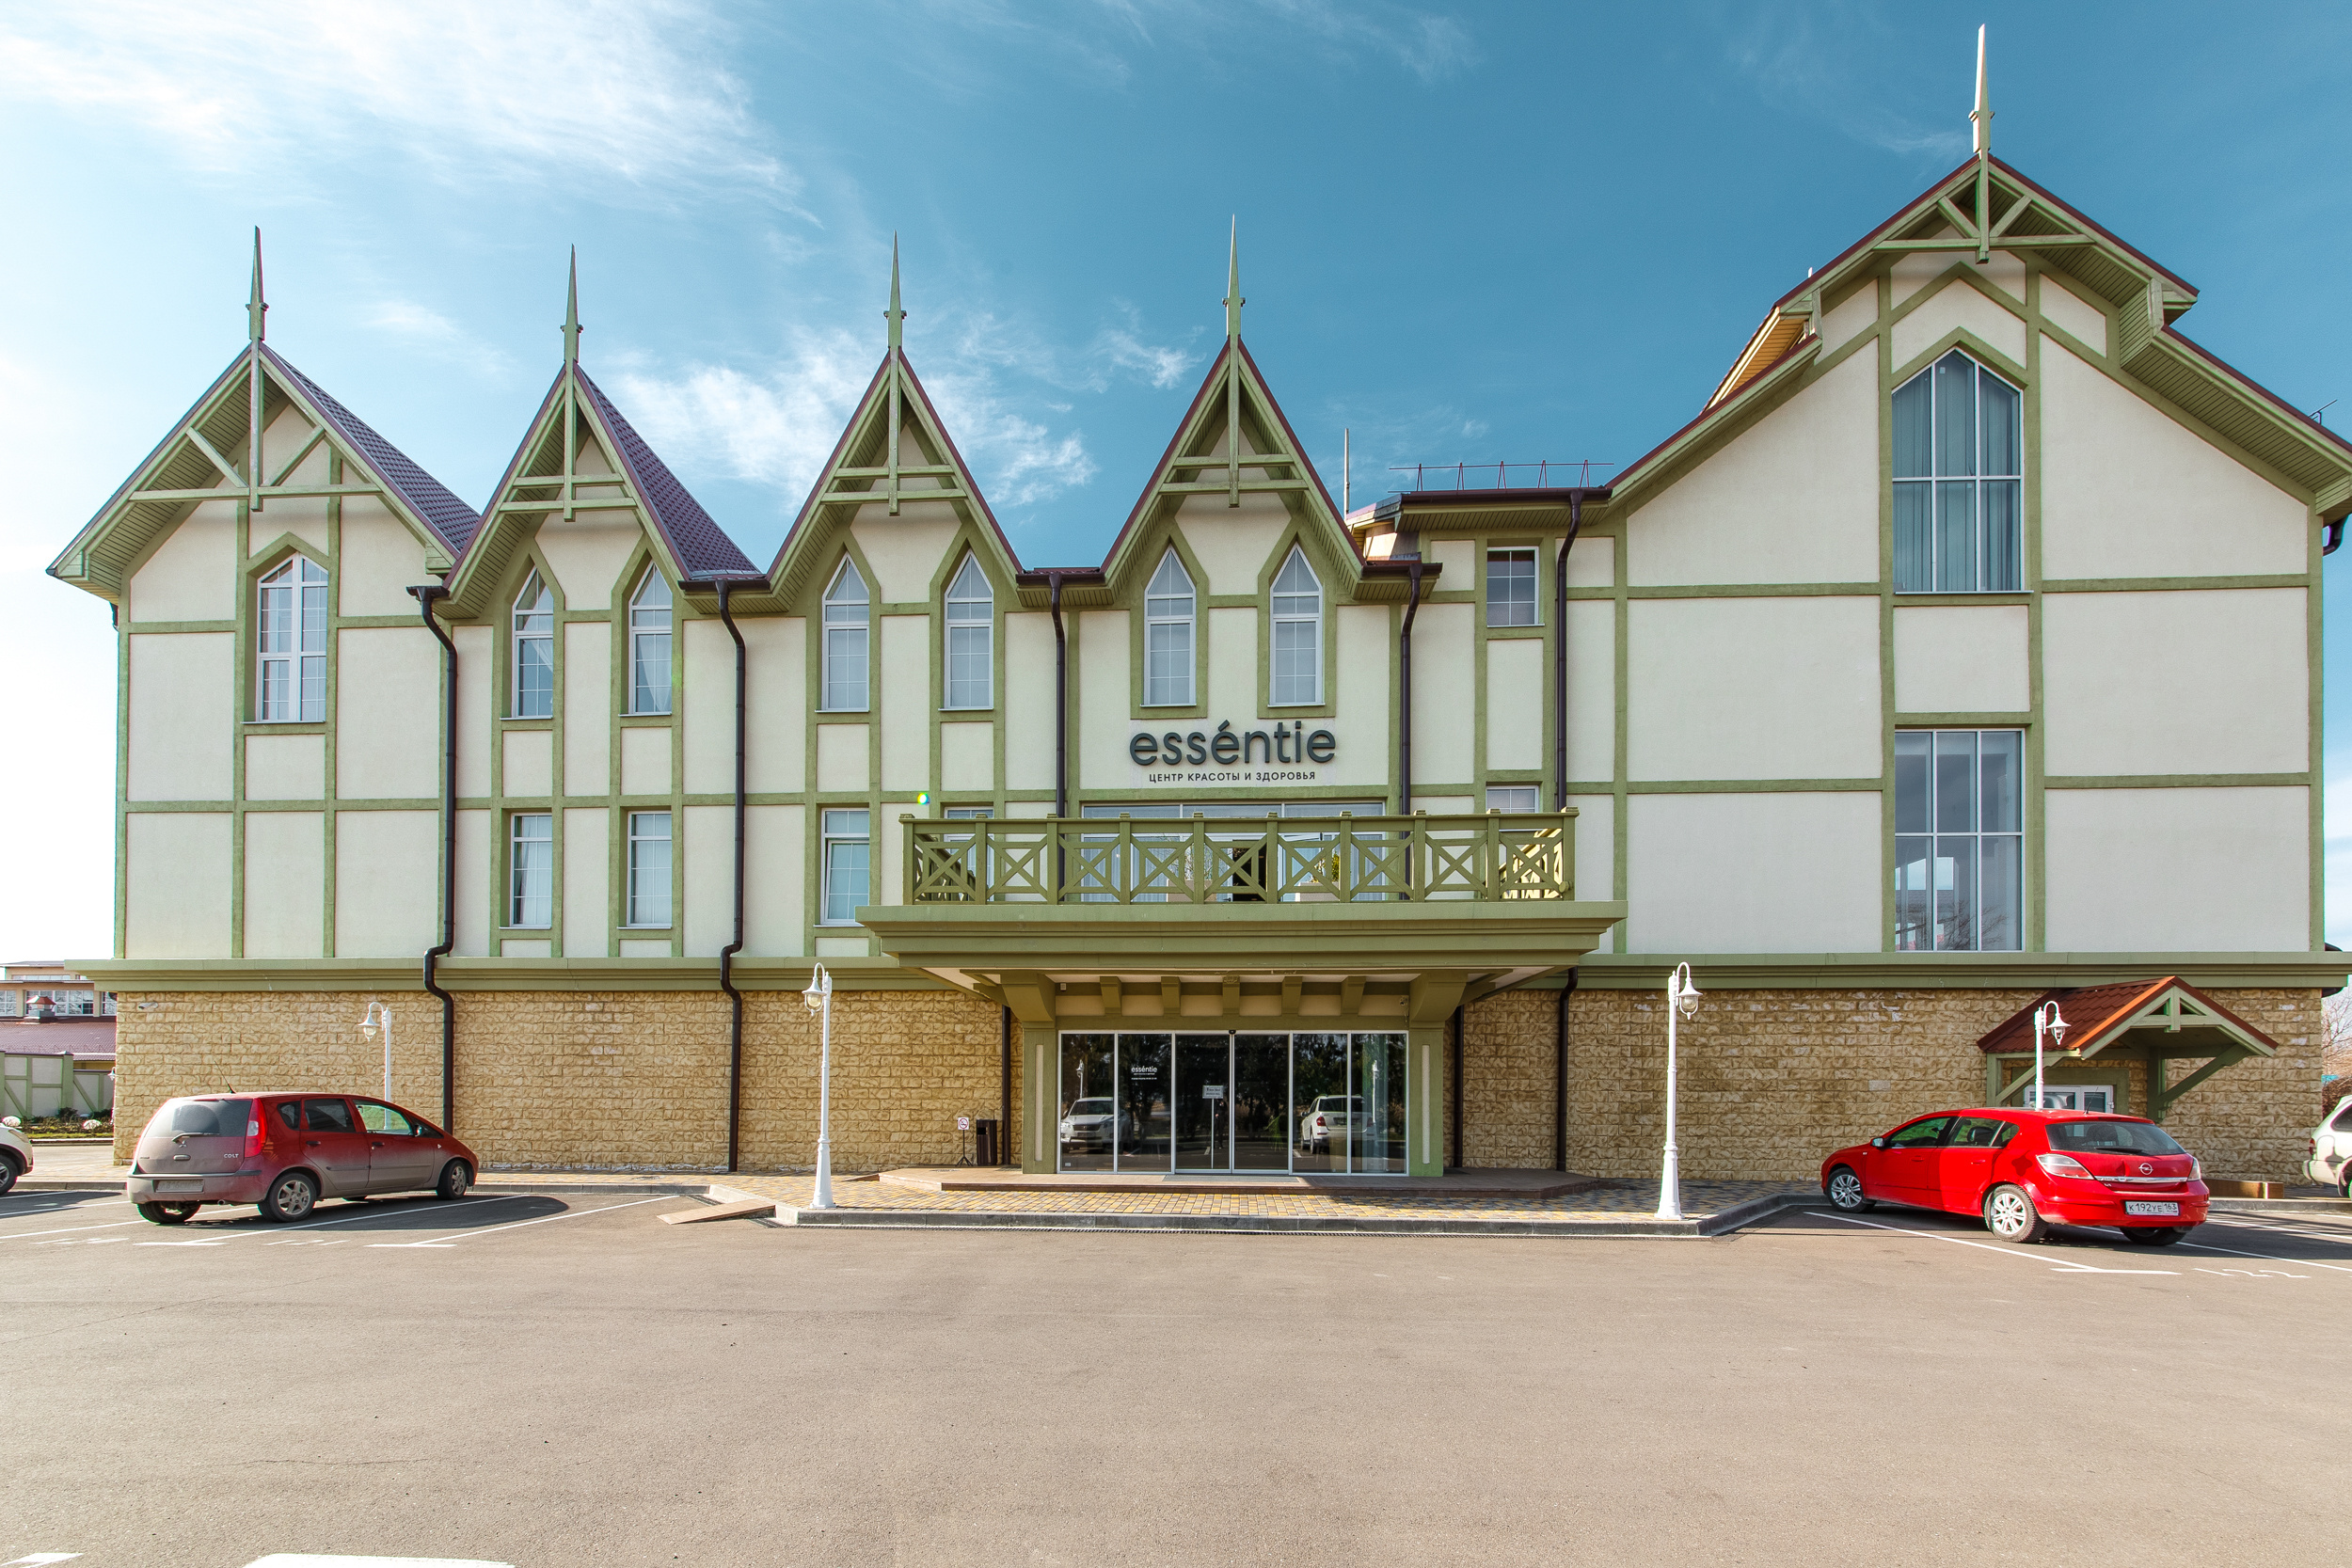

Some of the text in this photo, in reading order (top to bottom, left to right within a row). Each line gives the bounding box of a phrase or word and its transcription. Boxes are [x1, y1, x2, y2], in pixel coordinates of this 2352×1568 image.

[1129, 719, 1336, 766] esséntie
[1149, 771, 1315, 784] ЦЕНТР КРАСОТЫ И ЗДОРОВЬЯ
